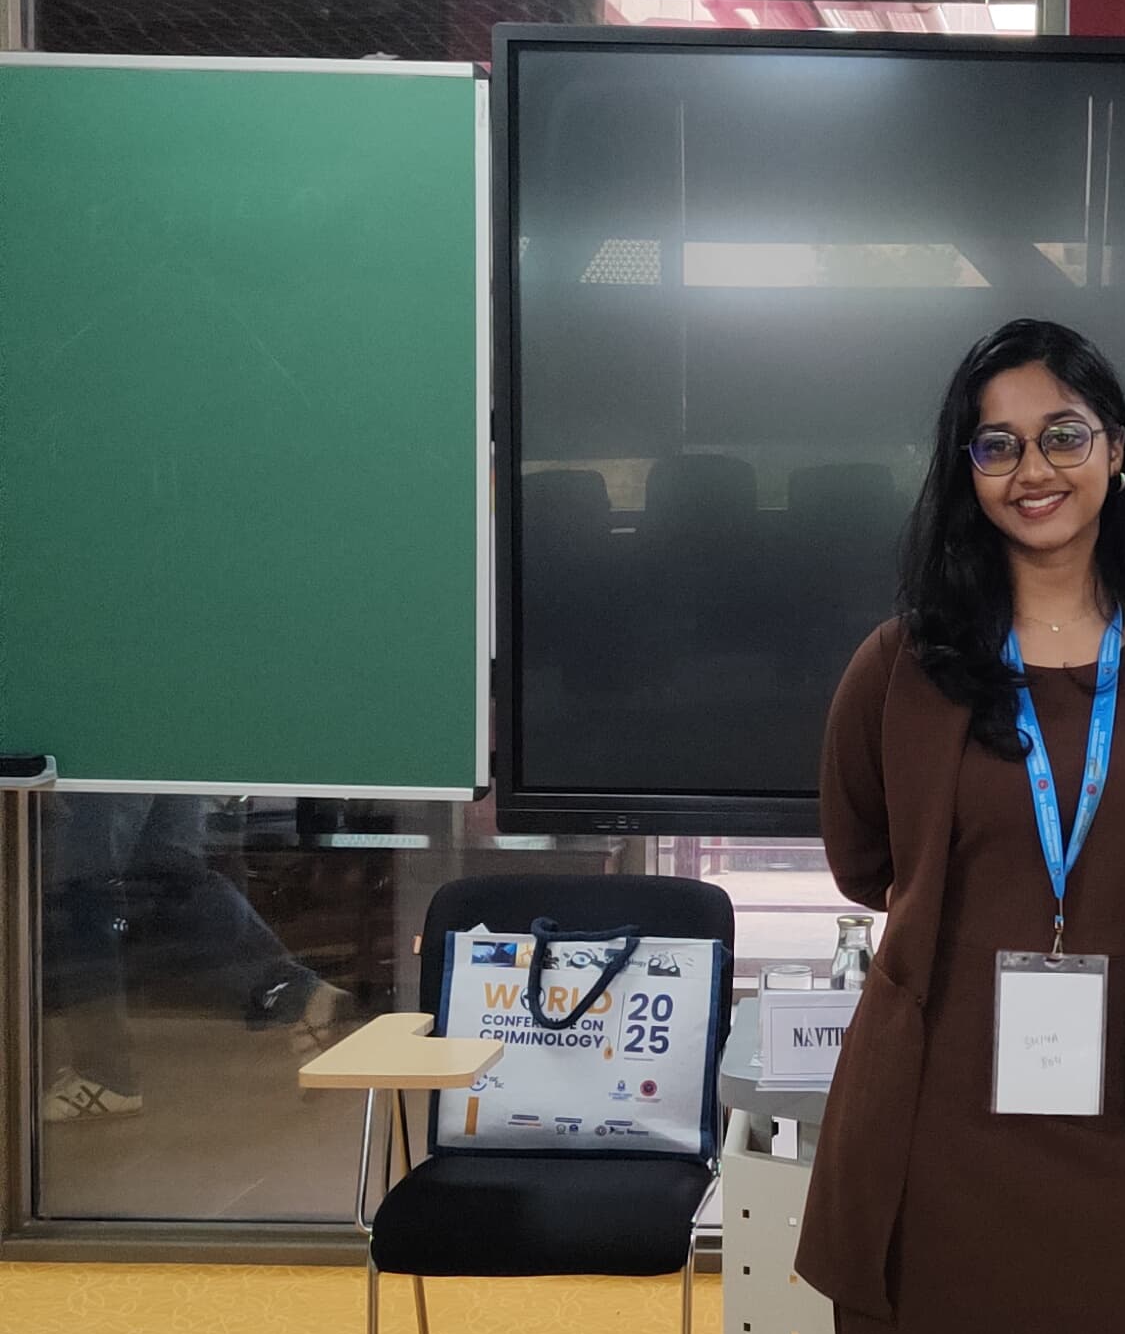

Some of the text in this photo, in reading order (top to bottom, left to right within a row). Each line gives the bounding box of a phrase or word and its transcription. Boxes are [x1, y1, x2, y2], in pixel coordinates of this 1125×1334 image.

[627, 992, 673, 1022] 20
[581, 1019, 604, 1032] ON
[480, 1028, 605, 1049] CRIMINOLOGY
[624, 1024, 670, 1054] 25
